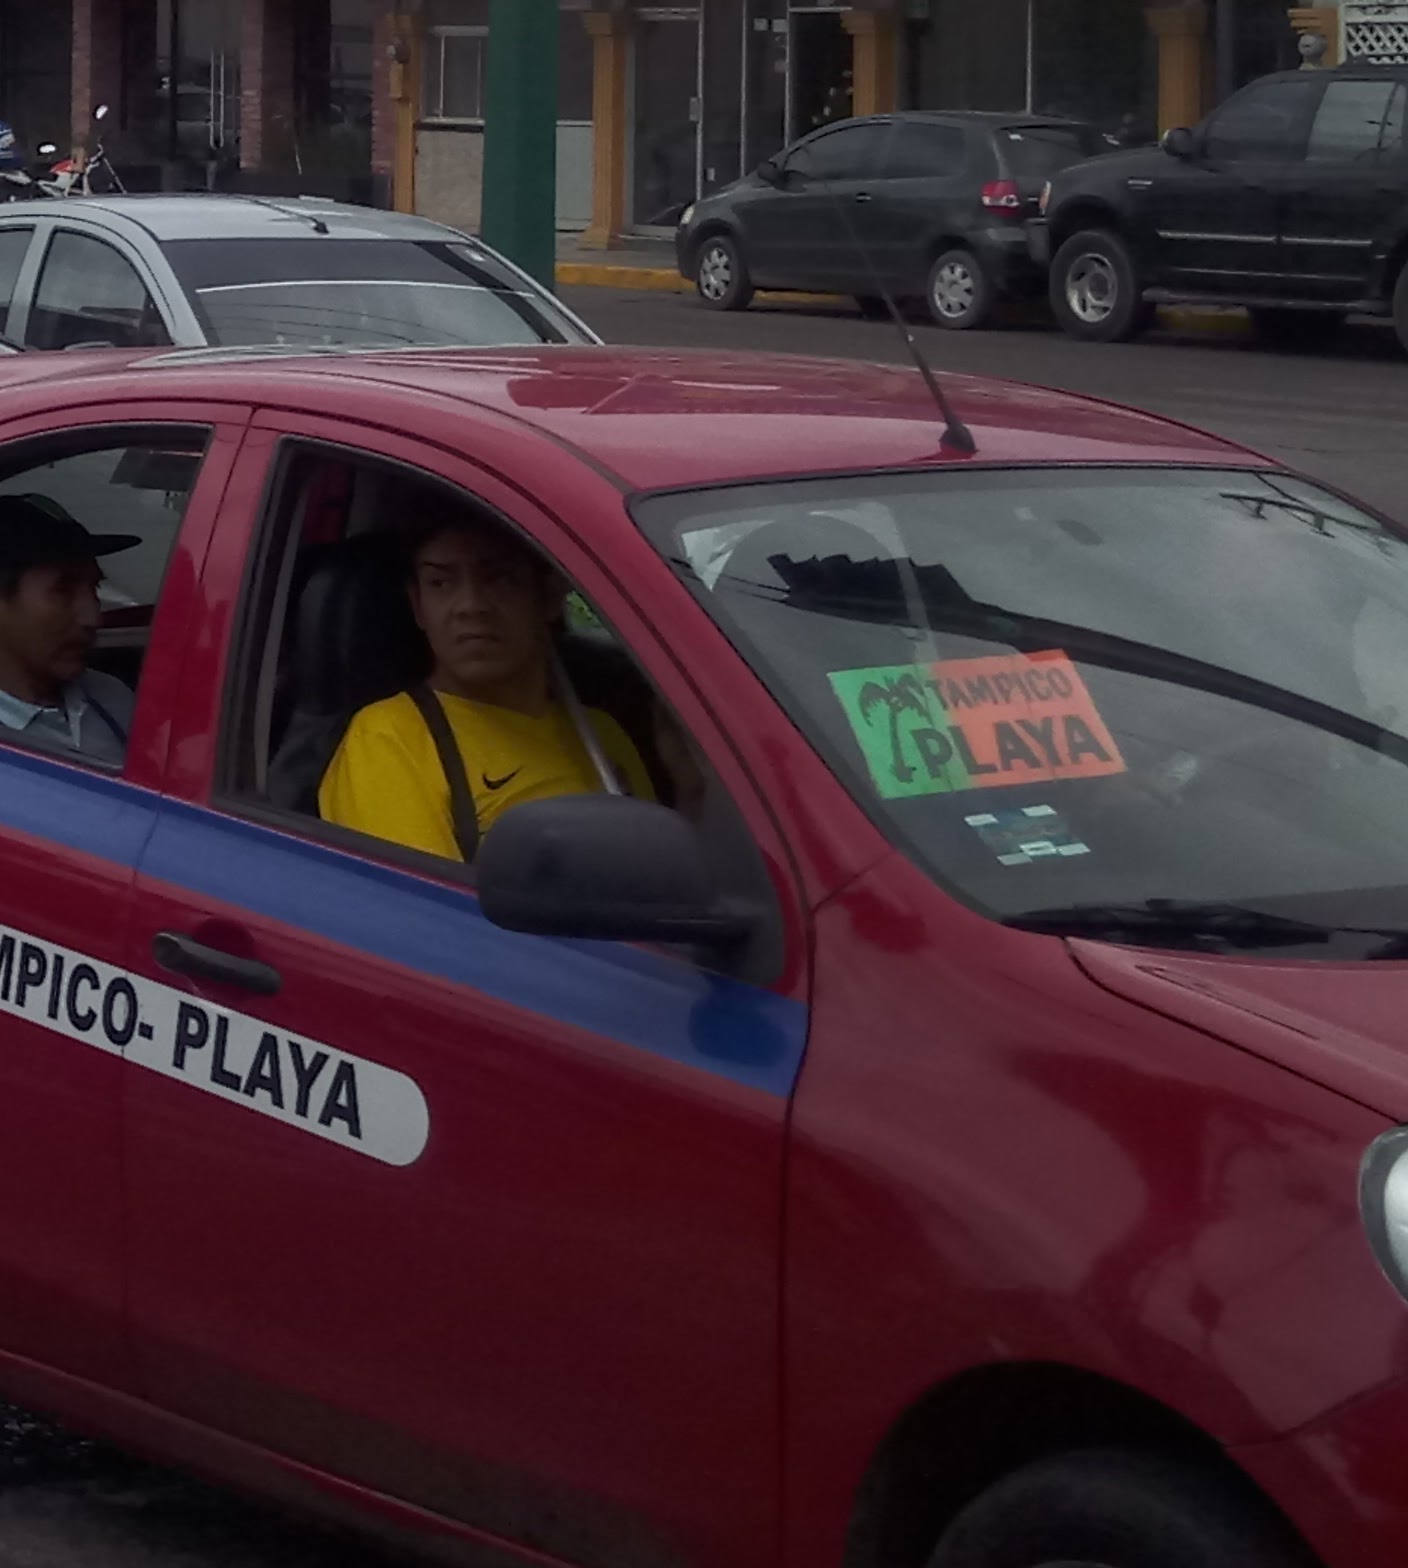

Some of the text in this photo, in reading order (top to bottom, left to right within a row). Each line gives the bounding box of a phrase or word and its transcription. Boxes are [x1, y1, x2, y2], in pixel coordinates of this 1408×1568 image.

[922, 666, 1075, 712] TAMPICO
[907, 713, 1114, 780] PLAYA
[171, 999, 364, 1141] PLAYA
